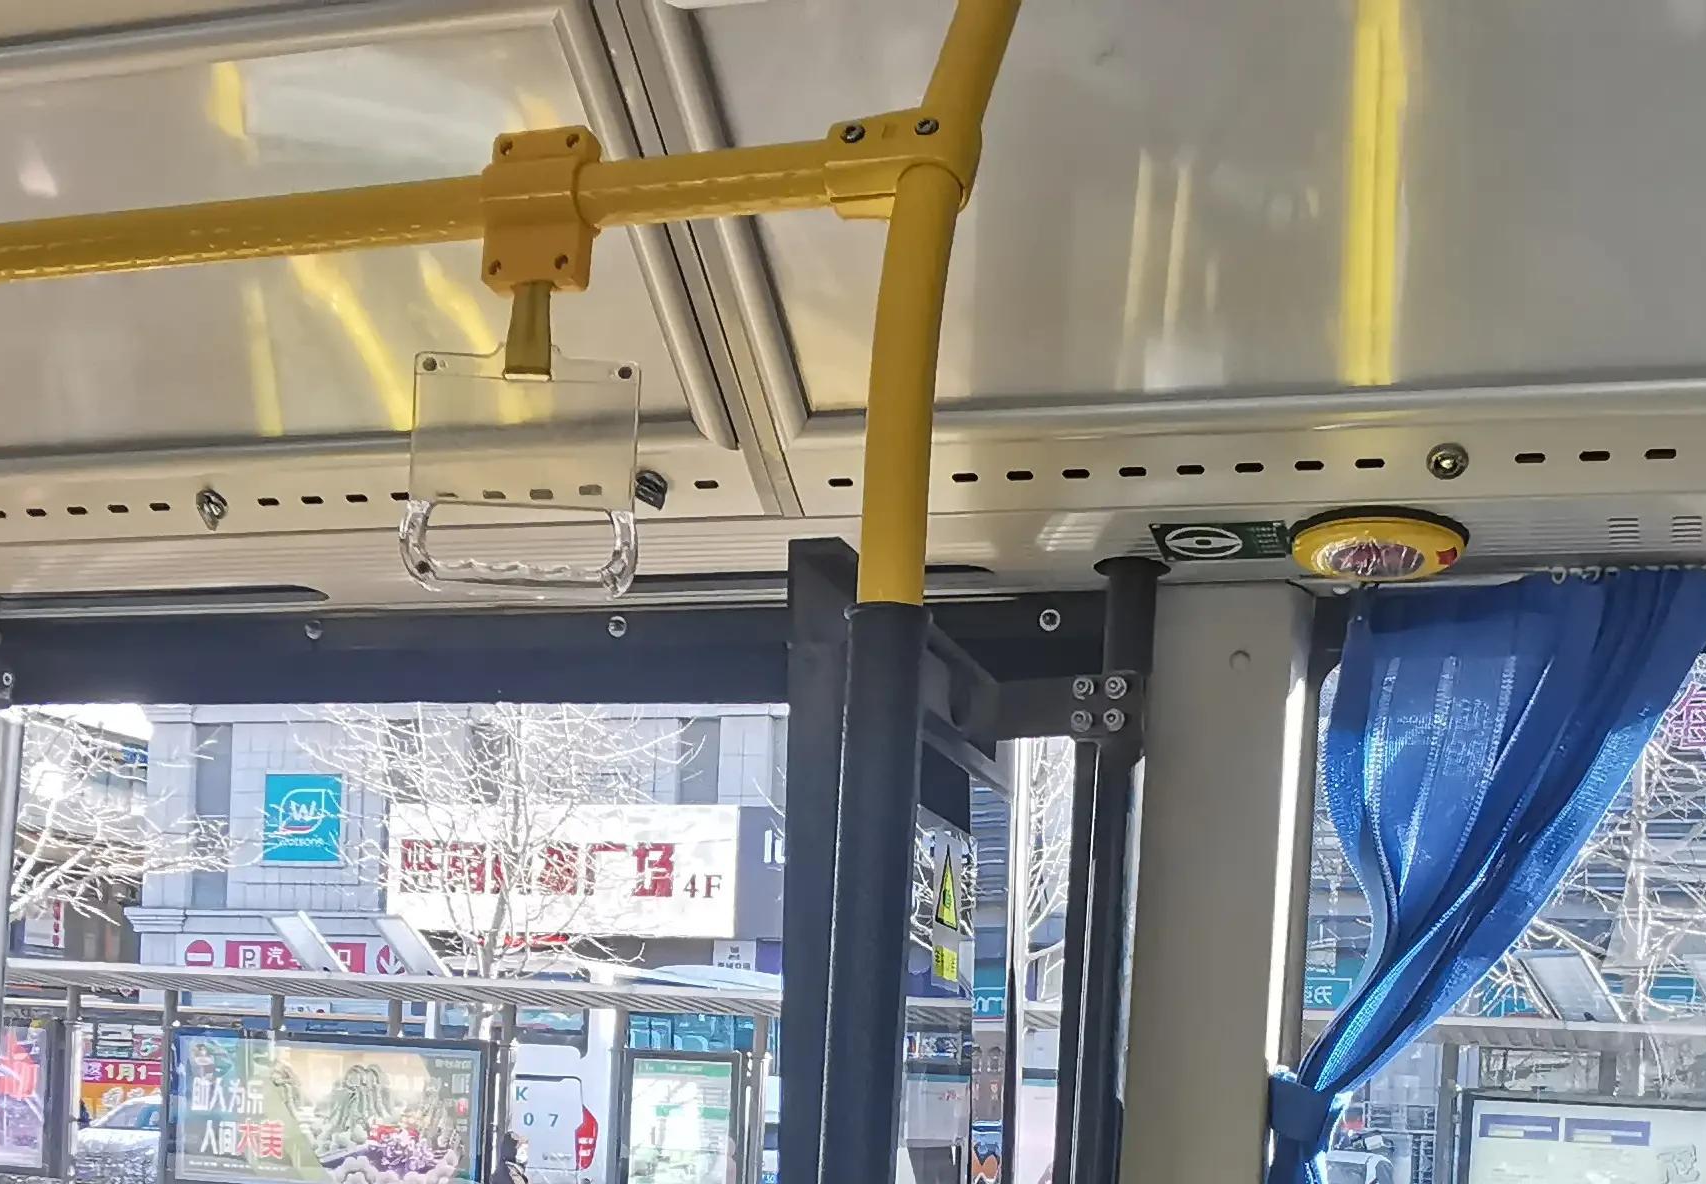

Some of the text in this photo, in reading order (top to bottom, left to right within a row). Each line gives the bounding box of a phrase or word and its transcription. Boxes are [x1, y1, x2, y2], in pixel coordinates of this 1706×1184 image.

[683, 874, 723, 898] 4F
[191, 1077, 264, 1114] 助人为乐
